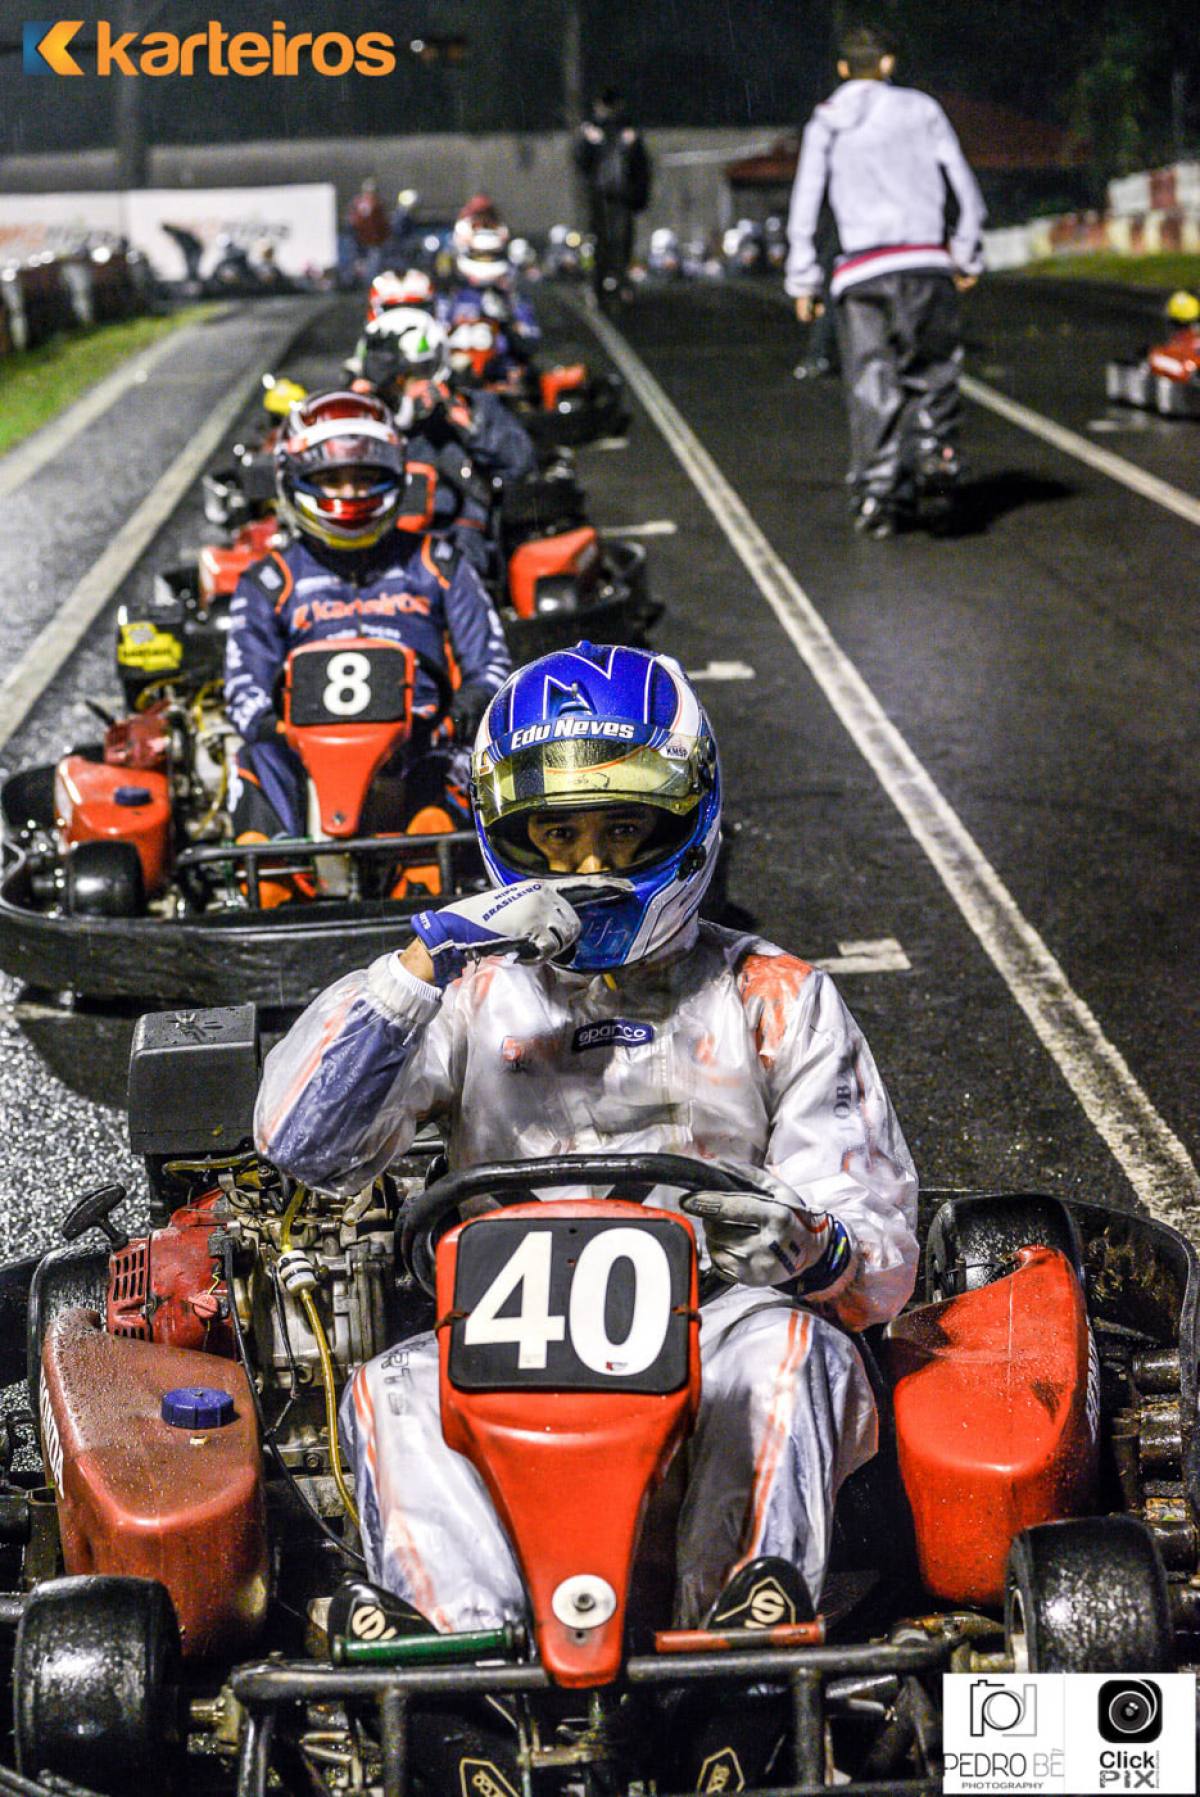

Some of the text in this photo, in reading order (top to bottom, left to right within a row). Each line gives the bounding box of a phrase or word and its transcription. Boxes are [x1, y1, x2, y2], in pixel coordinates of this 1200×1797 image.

[323, 652, 371, 716] 8
[511, 719, 635, 750] Edu Neves
[482, 883, 542, 922] BRASILEIRO
[578, 1024, 647, 1046] sparco
[464, 1227, 672, 1376] 40
